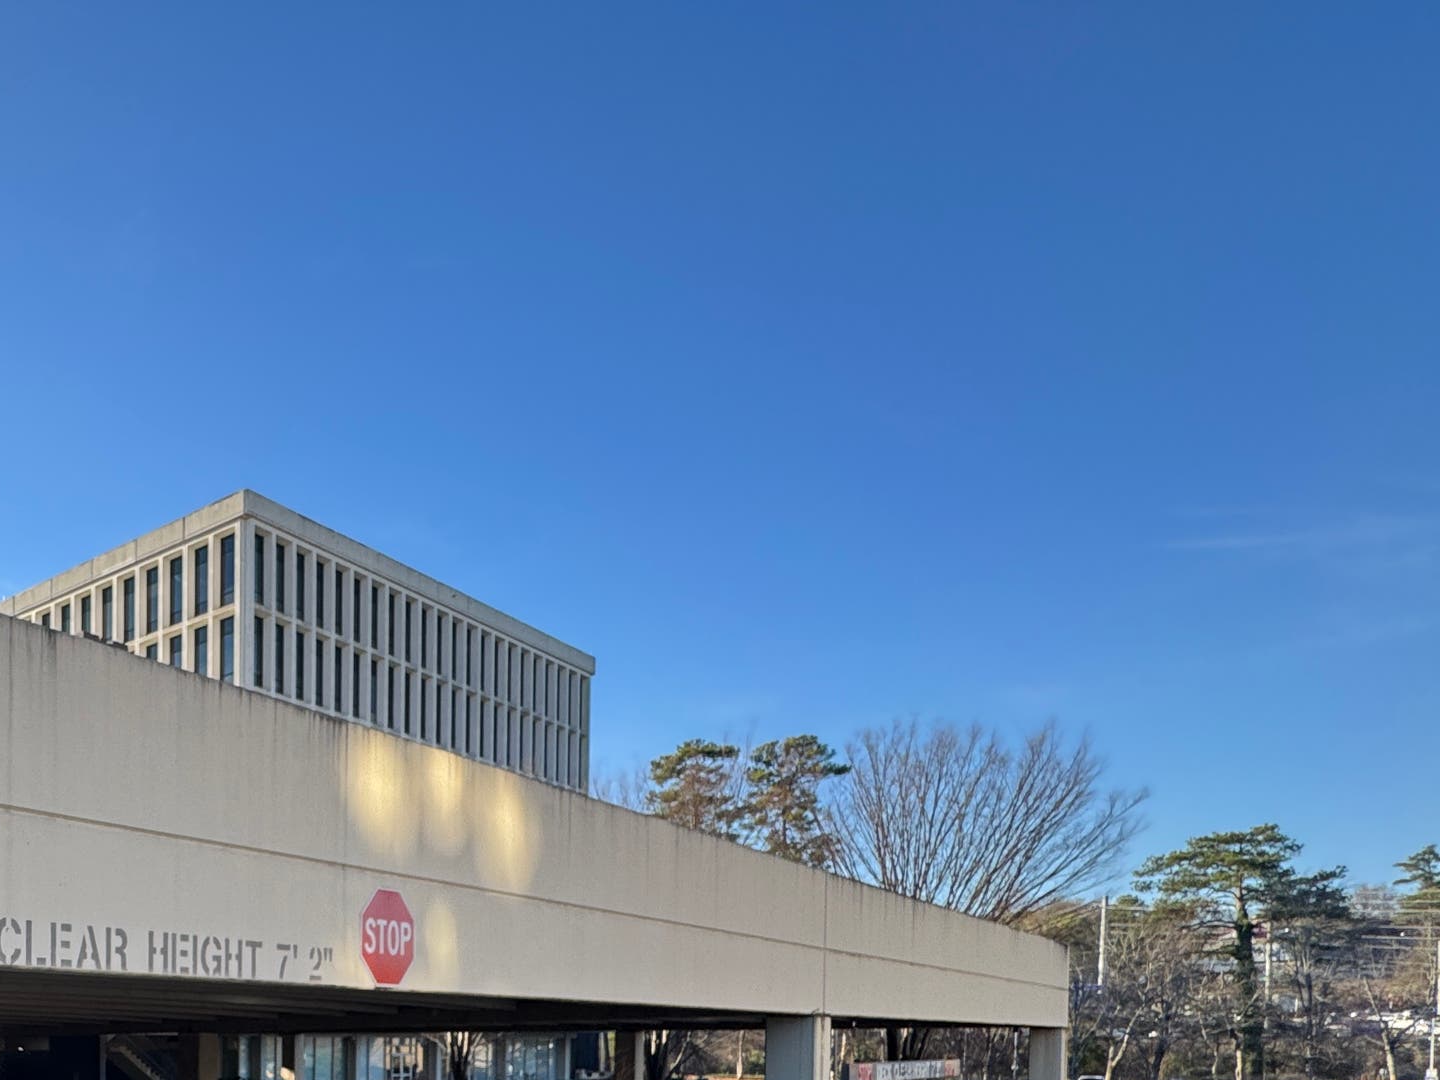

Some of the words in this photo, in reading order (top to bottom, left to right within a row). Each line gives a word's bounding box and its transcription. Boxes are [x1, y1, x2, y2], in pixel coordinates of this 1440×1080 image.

[148, 930, 263, 979] HEIGHT
[276, 943, 298, 979] 7'
[363, 917, 411, 957] STOP
